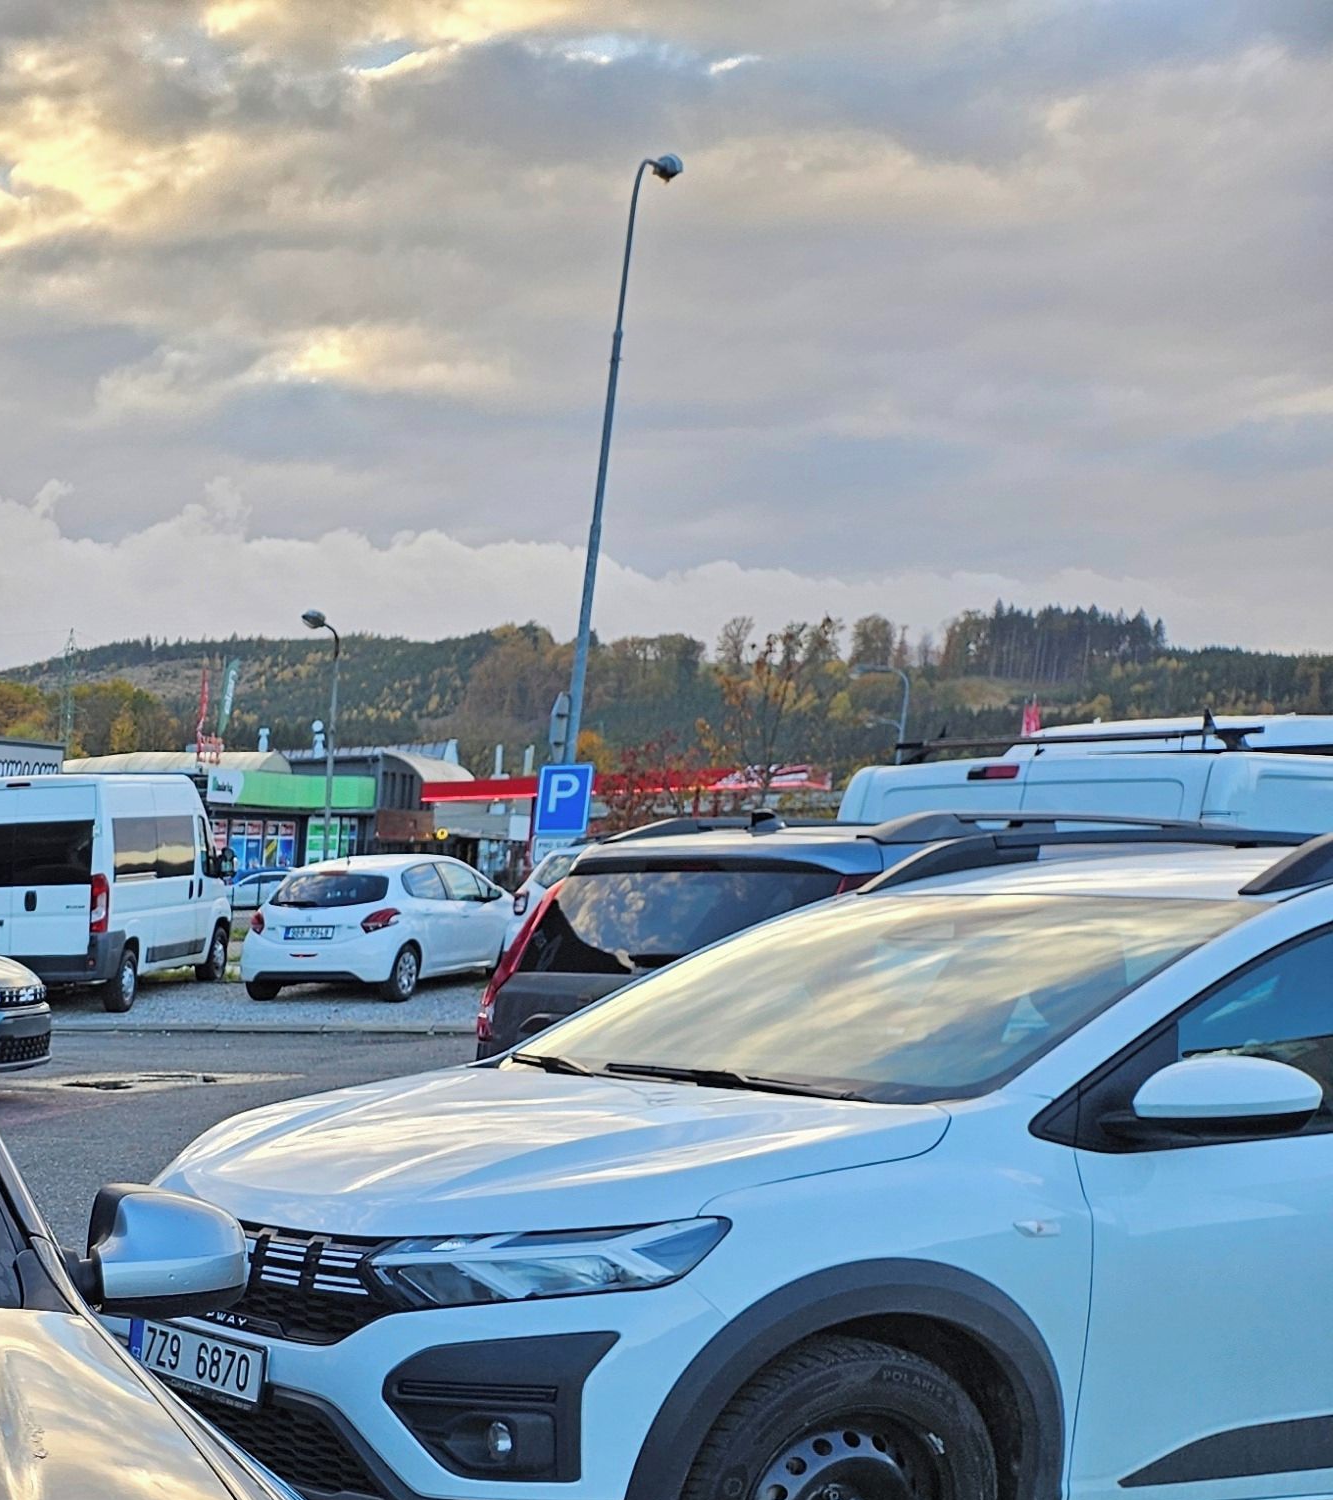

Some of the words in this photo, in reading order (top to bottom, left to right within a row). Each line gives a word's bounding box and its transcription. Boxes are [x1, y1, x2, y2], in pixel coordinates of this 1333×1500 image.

[547, 773, 580, 813] P
[144, 1325, 182, 1371] 7Z9
[195, 1342, 251, 1392] 6870
